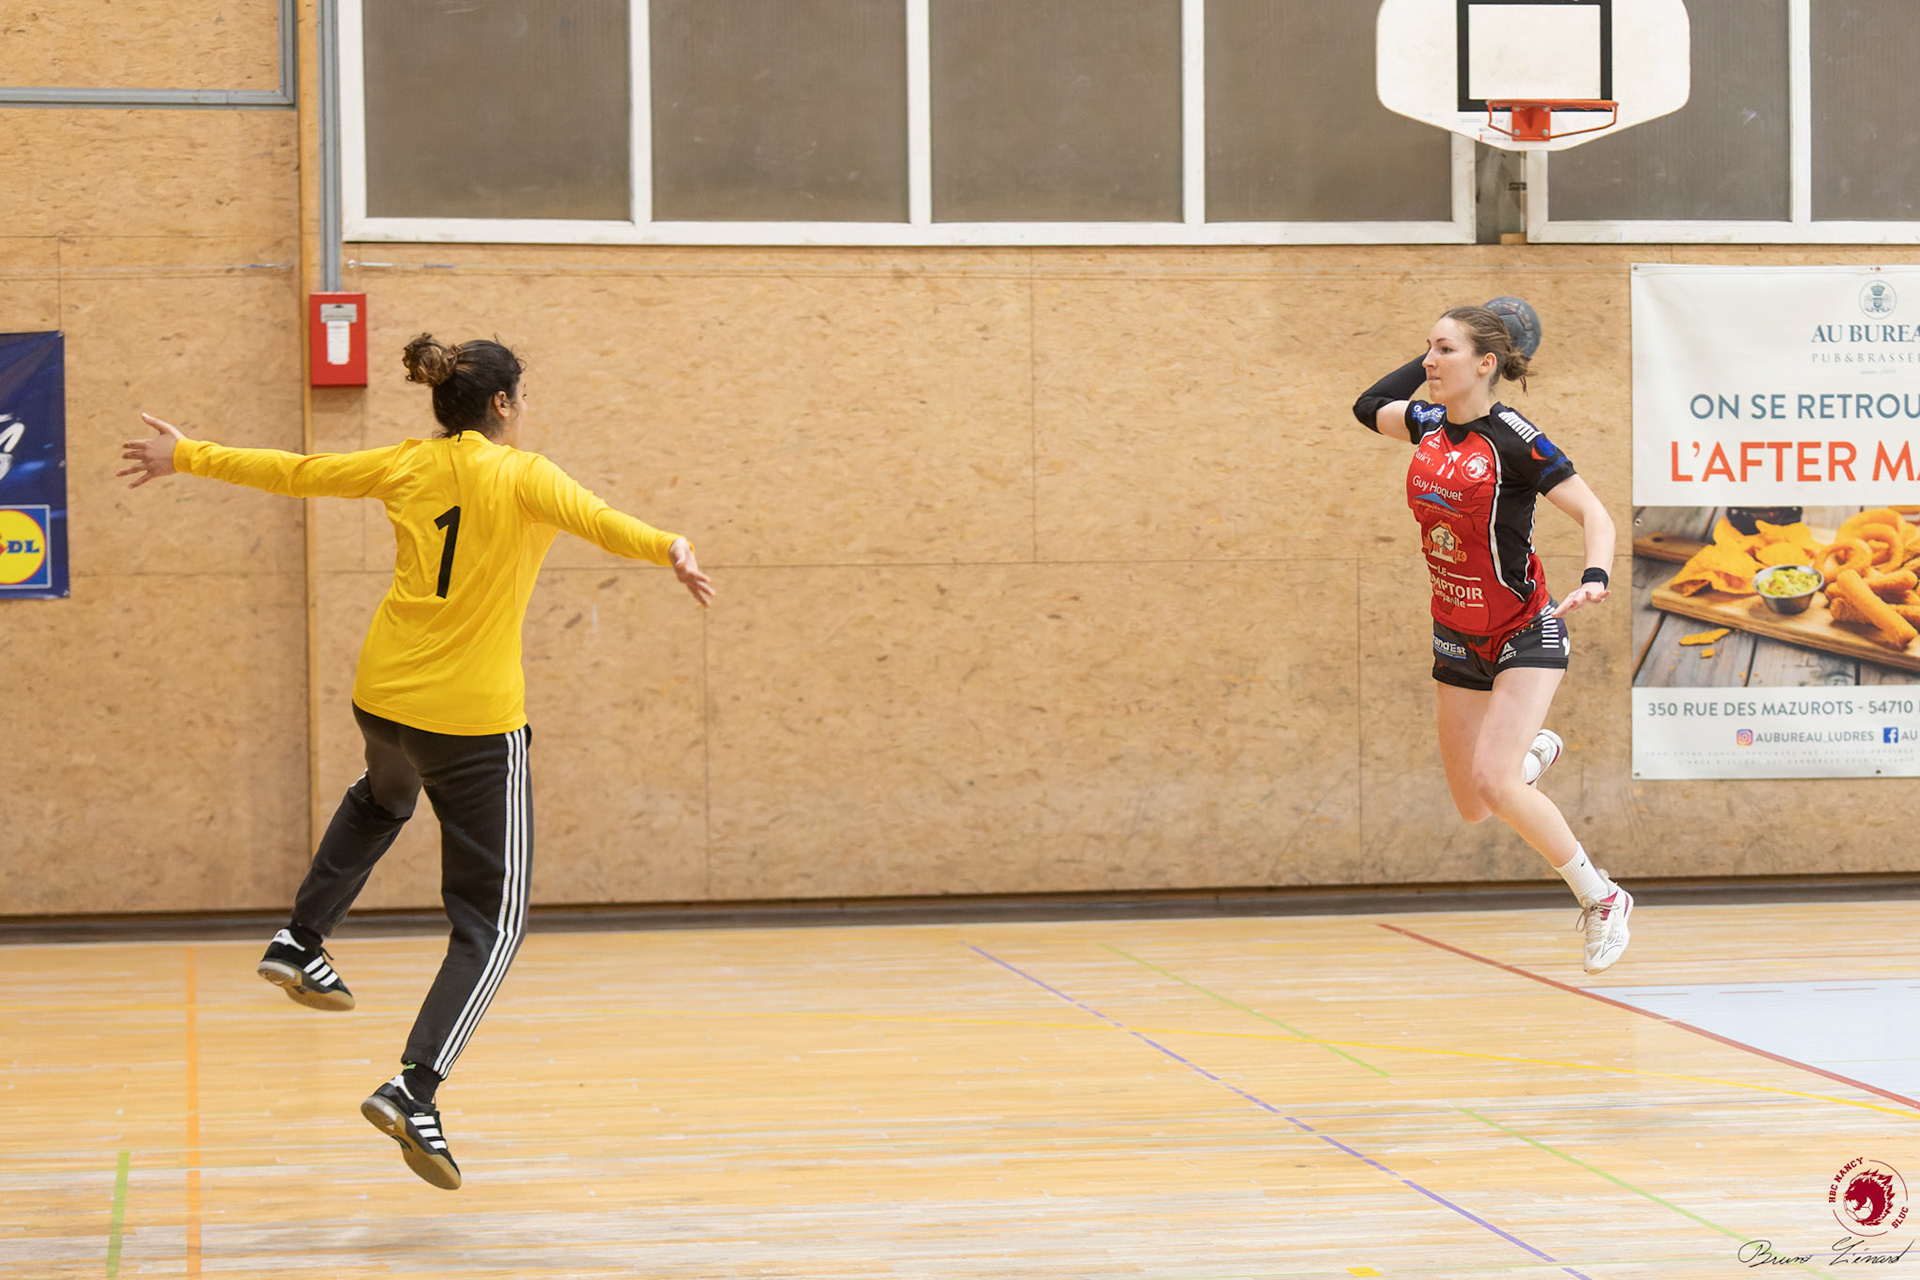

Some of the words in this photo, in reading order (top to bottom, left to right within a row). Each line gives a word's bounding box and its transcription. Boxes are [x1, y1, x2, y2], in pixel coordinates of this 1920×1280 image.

[1811, 324, 1843, 343] AU
[1690, 393, 1739, 419] ON
[1751, 393, 1786, 419] SE
[1797, 393, 1920, 419] RETROU
[1671, 440, 1857, 482] L'AFTER
[1872, 440, 1920, 482] M
[1412, 475, 1429, 491] Guy
[1429, 482, 1463, 501] Hoquet
[0, 537, 40, 554] DL
[434, 505, 461, 599] 1
[1437, 565, 1447, 577] LE
[1430, 574, 1484, 600] MPTOIR
[1648, 702, 1677, 716] 350
[1683, 702, 1718, 716] RUE
[1724, 701, 1756, 716] DES
[1761, 700, 1854, 716] MAZUROTS
[1868, 699, 1914, 714] 54710
